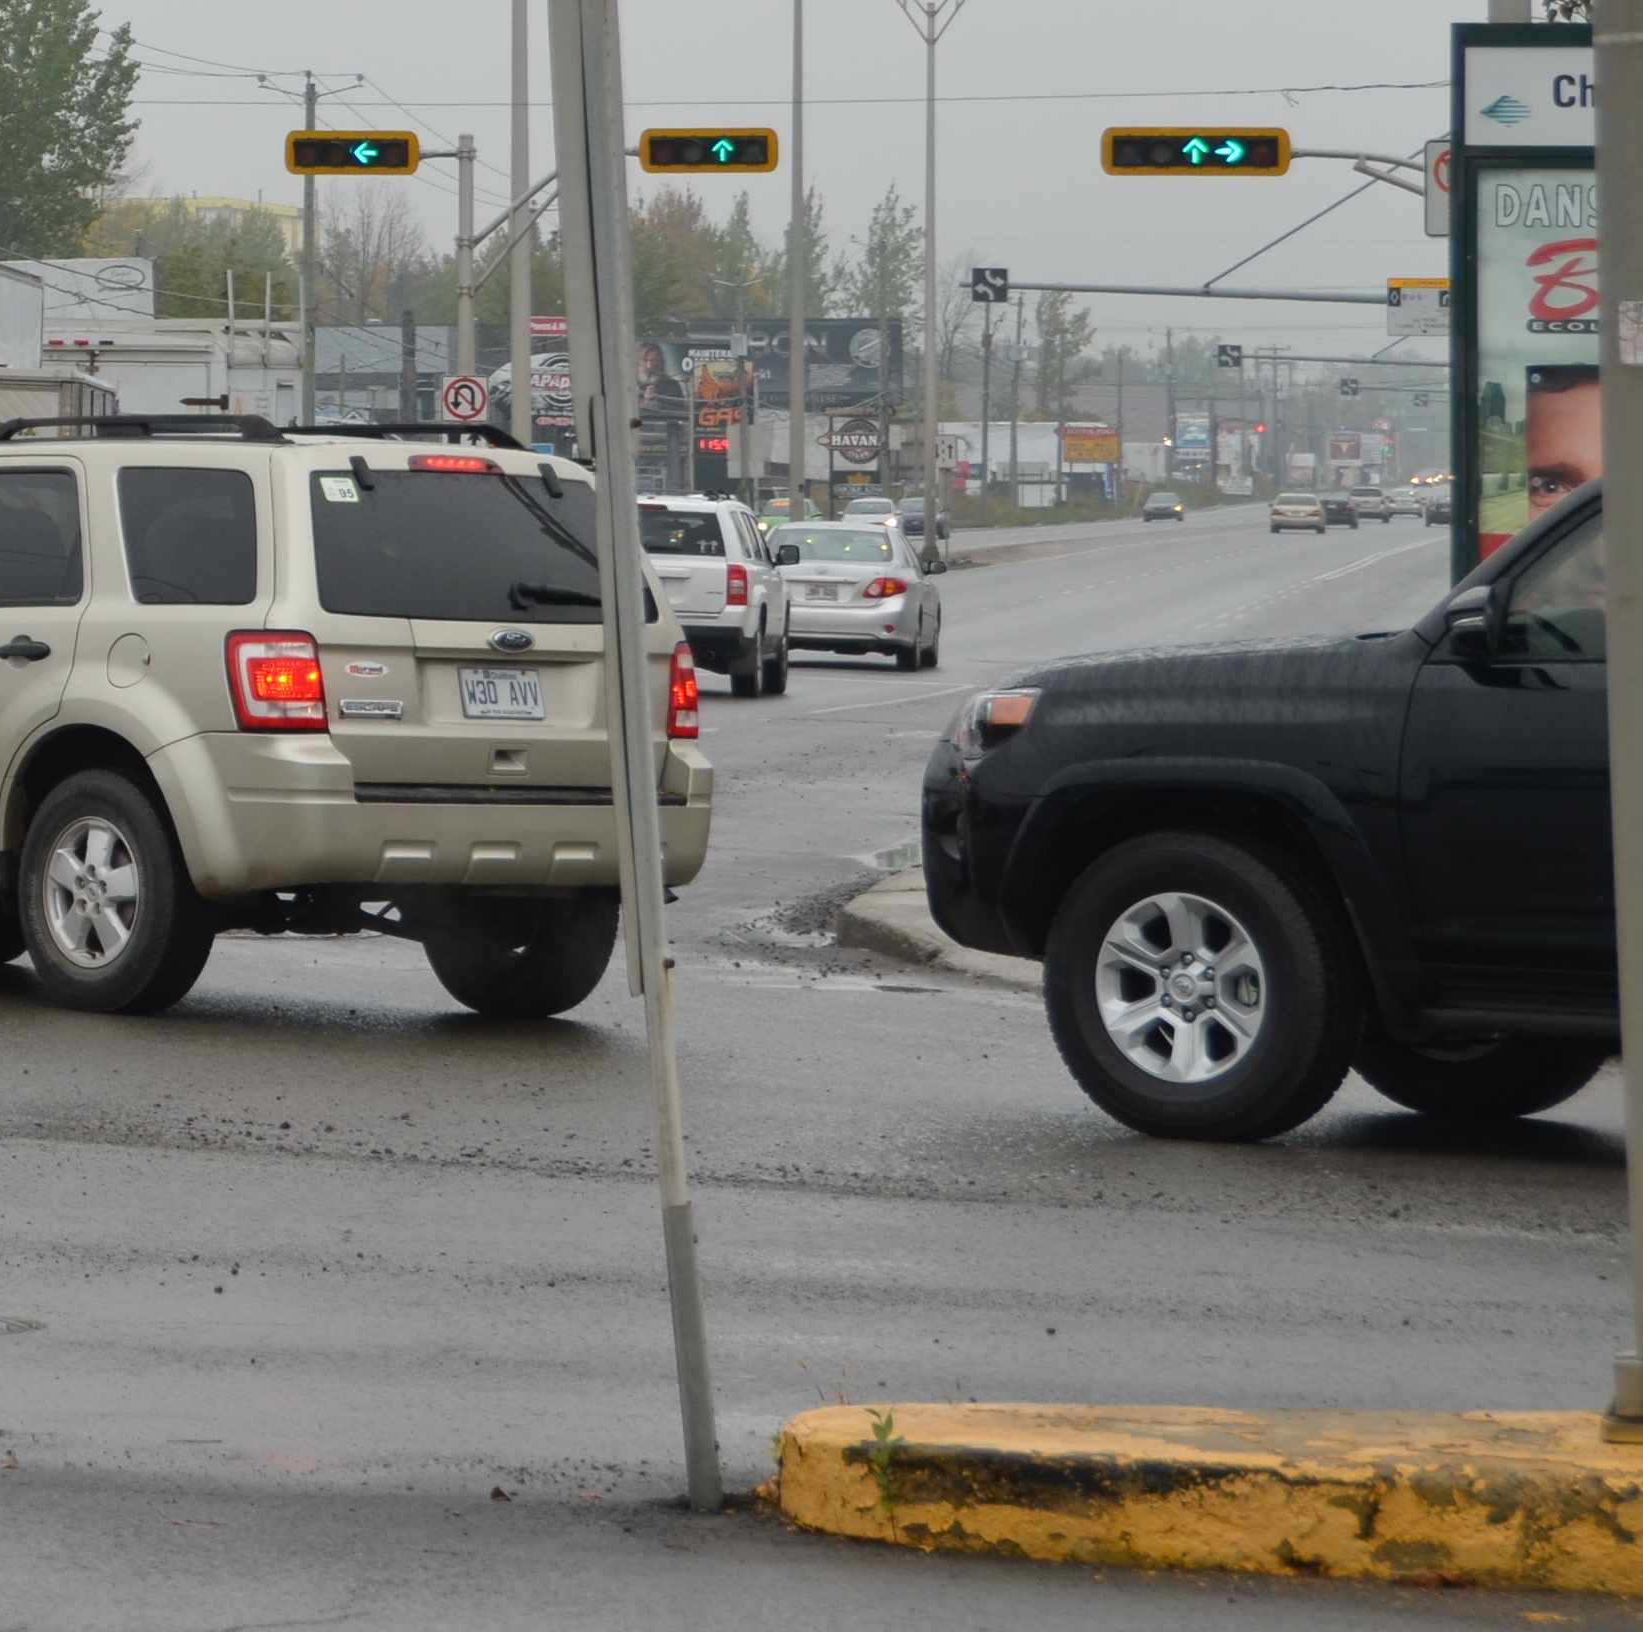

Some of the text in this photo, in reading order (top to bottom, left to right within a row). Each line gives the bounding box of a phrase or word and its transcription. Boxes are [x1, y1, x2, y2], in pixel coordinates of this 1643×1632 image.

[831, 435, 880, 446] HAVAN
[338, 487, 355, 499] 95
[464, 680, 539, 706] W30 AVV
[343, 701, 400, 712] ESCAPE
